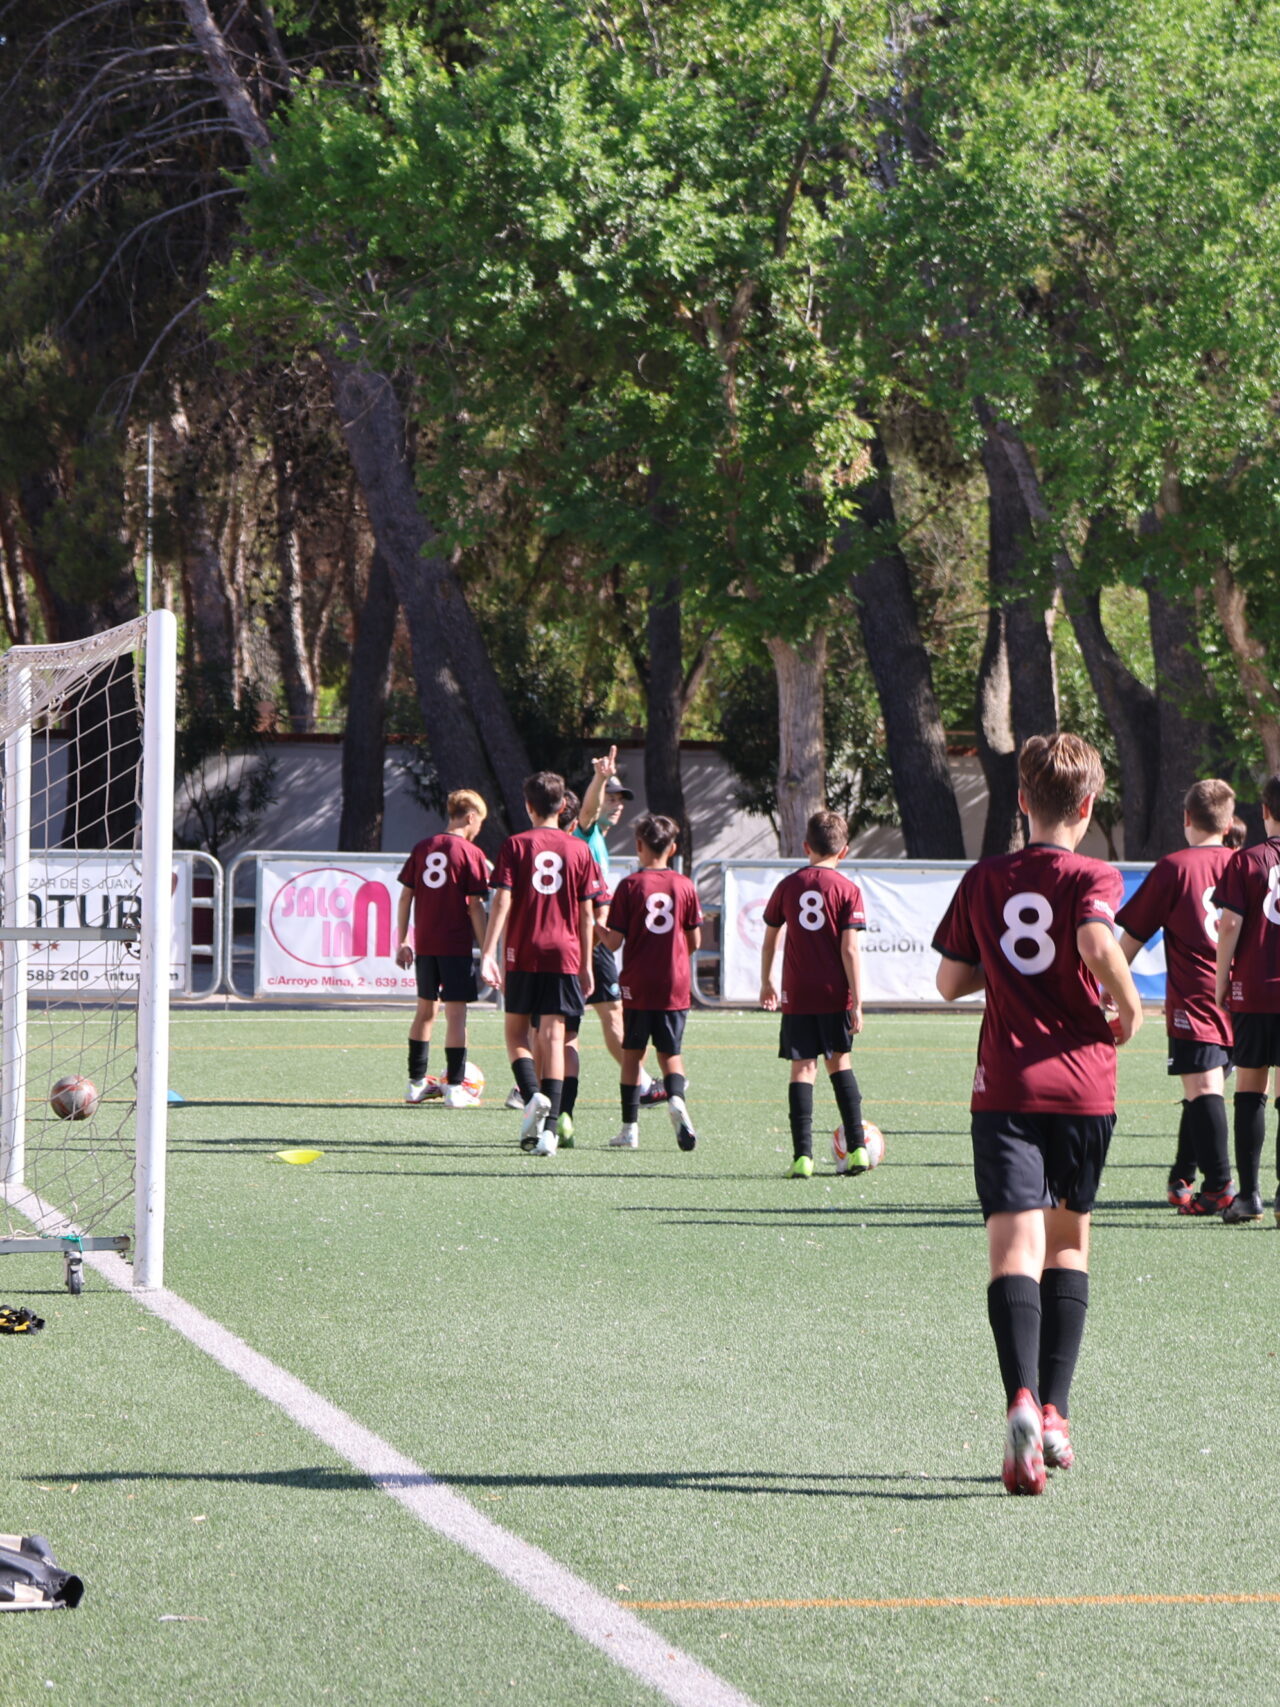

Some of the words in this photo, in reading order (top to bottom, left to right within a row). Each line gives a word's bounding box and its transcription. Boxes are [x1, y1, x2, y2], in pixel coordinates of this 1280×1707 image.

[29, 878, 55, 889] ZAR
[60, 879, 78, 889] DE
[98, 878, 132, 890] JUAN
[423, 852, 447, 888] 8
[532, 850, 562, 896] 8
[645, 892, 674, 934] 8
[799, 890, 825, 931] 8
[1000, 892, 1055, 975] 8
[60, 970, 89, 982] 200
[268, 976, 318, 988] c/Arroyo
[321, 976, 354, 988] Mina,
[358, 977, 366, 987] 2
[375, 977, 397, 987] 639
